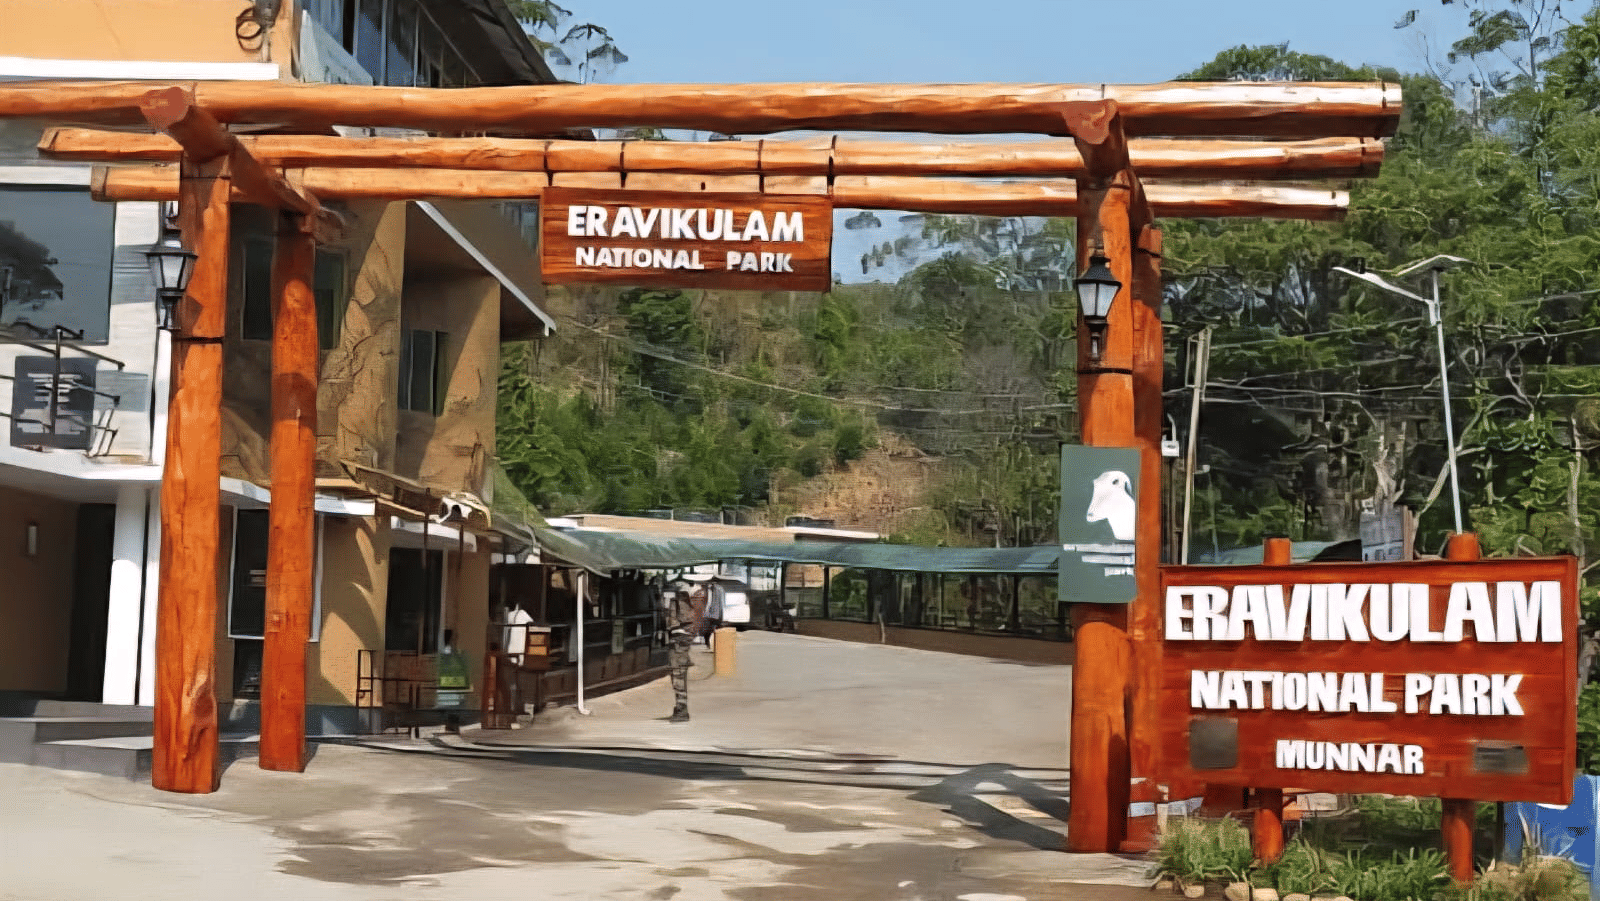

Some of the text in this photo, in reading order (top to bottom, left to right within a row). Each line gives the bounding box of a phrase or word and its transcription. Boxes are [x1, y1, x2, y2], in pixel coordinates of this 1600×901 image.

[567, 205, 804, 242] ERAVIKULAM
[575, 246, 794, 273] NATIONAL PARK
[1165, 580, 1564, 643] ERAVIKULAM
[1190, 669, 1525, 716] NATIONAL PARK
[1275, 739, 1425, 775] MUNNAR
